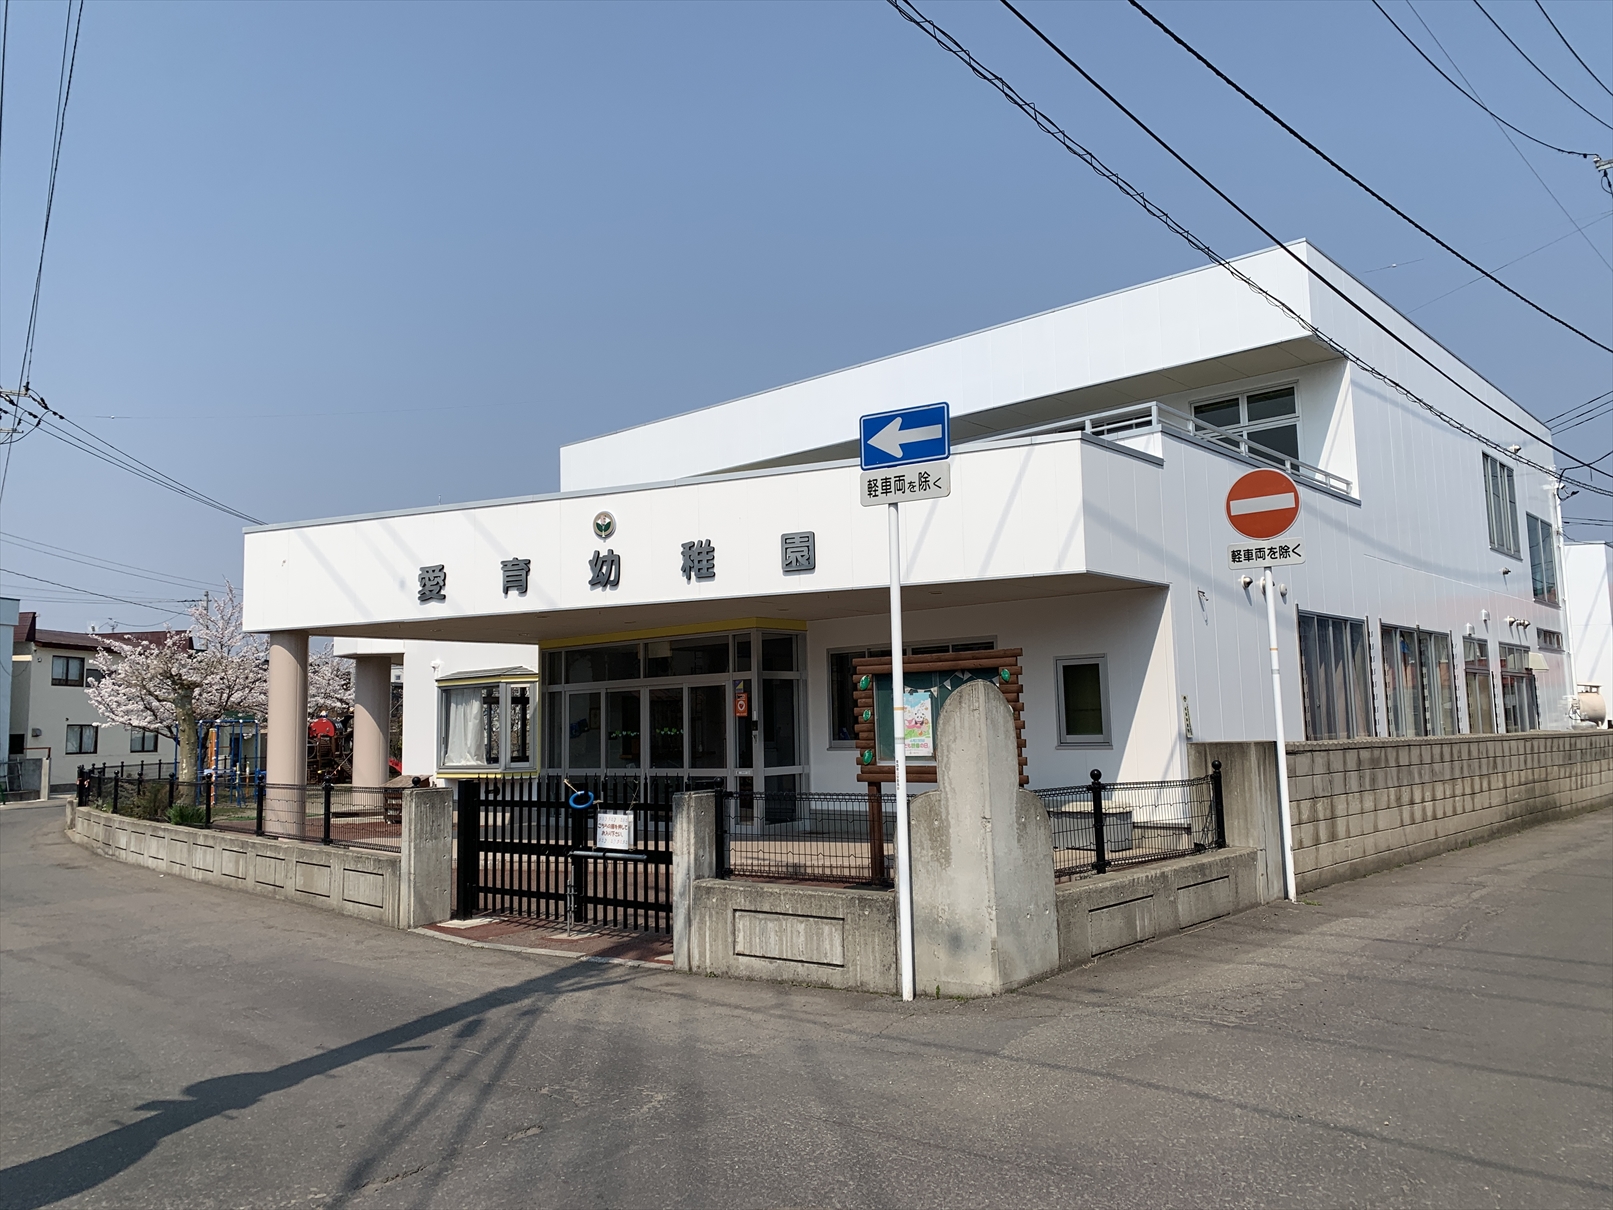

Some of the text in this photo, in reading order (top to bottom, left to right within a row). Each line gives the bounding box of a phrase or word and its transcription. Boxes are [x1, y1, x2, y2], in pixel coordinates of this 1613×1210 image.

[867, 471, 942, 498] 軽車両を除く
[418, 531, 816, 602] 愛育幼稚園
[1231, 543, 1302, 563] 軽車両を除く
